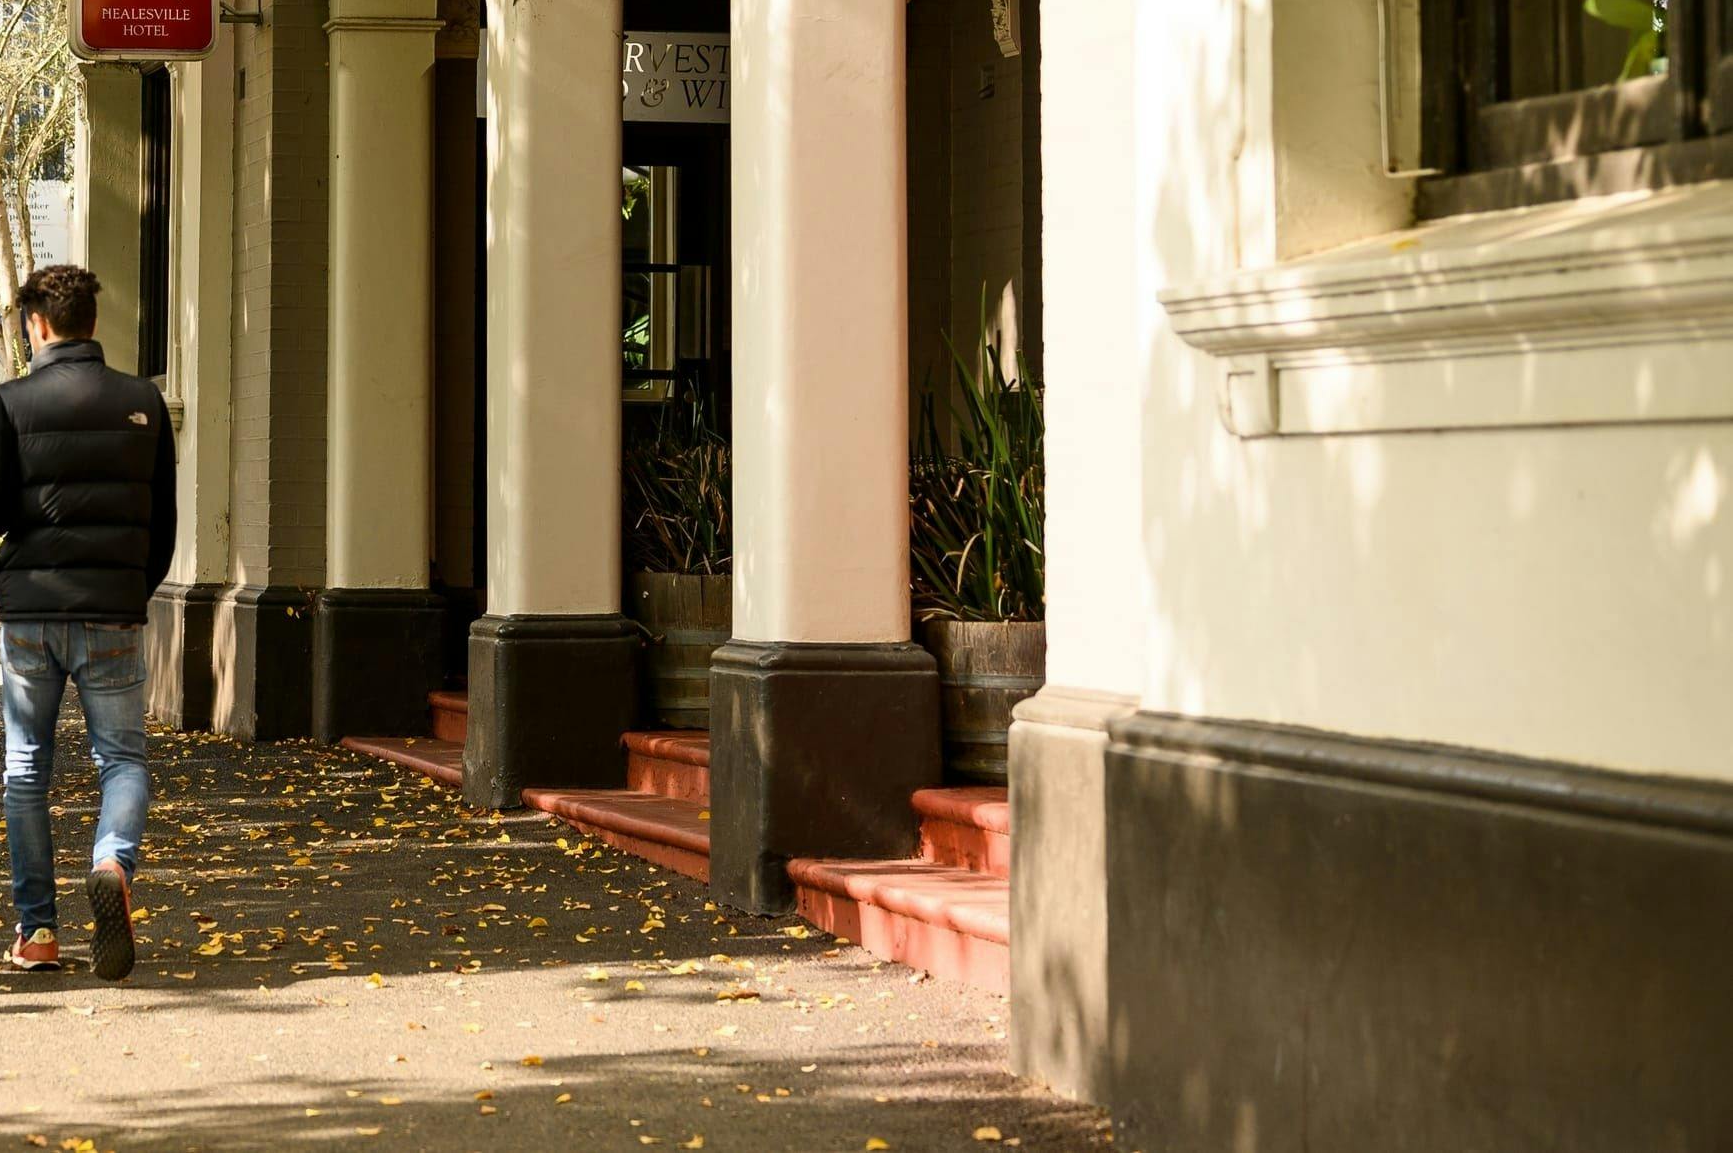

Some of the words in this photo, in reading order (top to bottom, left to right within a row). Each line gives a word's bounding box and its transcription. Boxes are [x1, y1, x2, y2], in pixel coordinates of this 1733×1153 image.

[101, 8, 191, 21] HEALESVILLE
[123, 24, 169, 37] HOTEL
[623, 42, 730, 74] RVEST
[641, 78, 670, 108] &
[681, 79, 730, 109] WI
